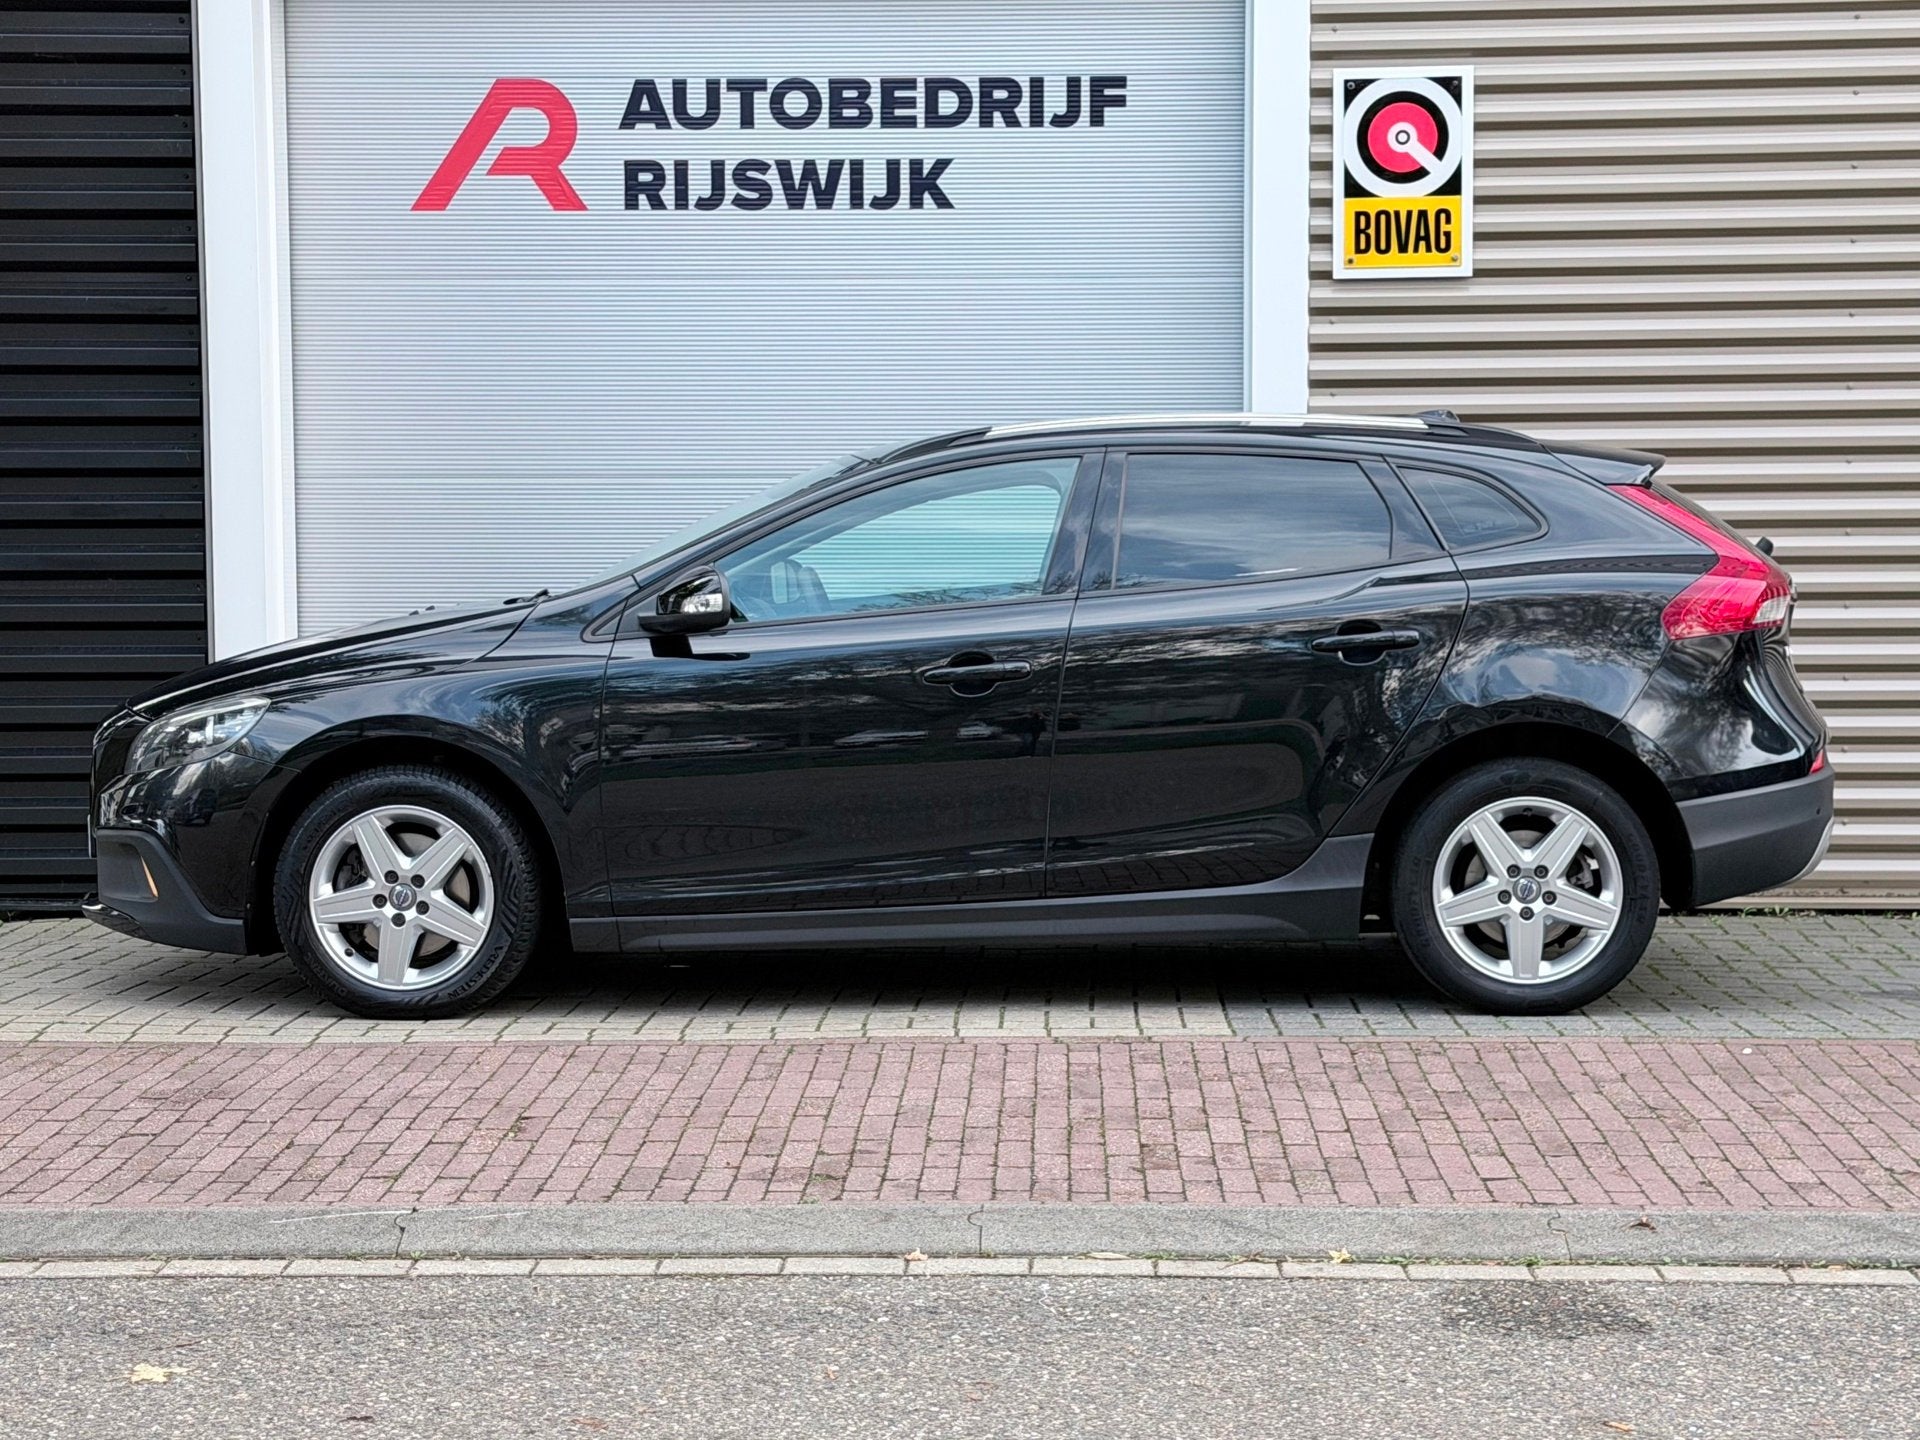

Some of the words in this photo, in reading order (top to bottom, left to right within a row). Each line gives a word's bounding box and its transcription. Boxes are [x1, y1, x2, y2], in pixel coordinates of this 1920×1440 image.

[619, 76, 1128, 131] AUTOBEDRIJF
[623, 158, 955, 212] RIJSWIJK
[1354, 208, 1452, 256] BOVAG
[448, 943, 505, 1000] VREDESTEIN
